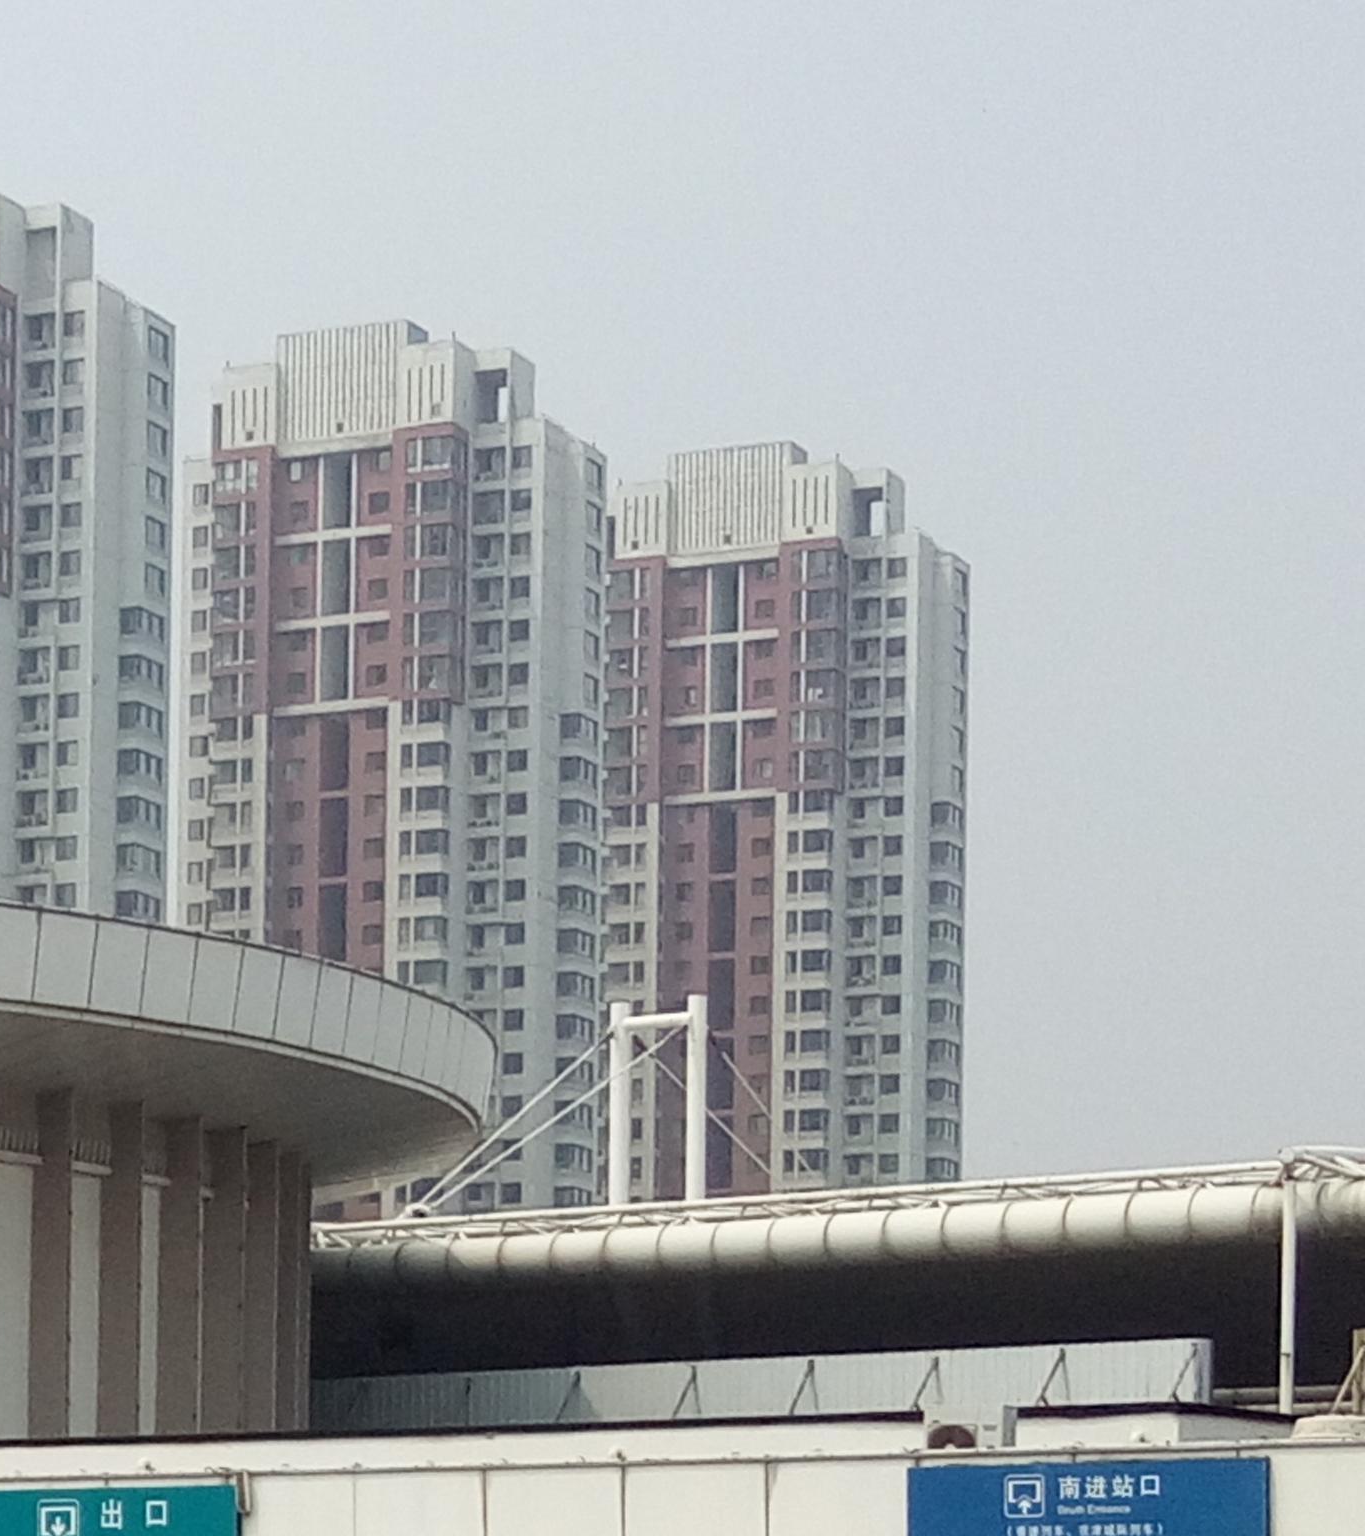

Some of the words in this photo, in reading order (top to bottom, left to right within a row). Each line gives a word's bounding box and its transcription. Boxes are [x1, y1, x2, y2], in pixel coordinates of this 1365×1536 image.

[1058, 1475, 1161, 1500] 南进站口
[101, 1499, 168, 1530] 出口
